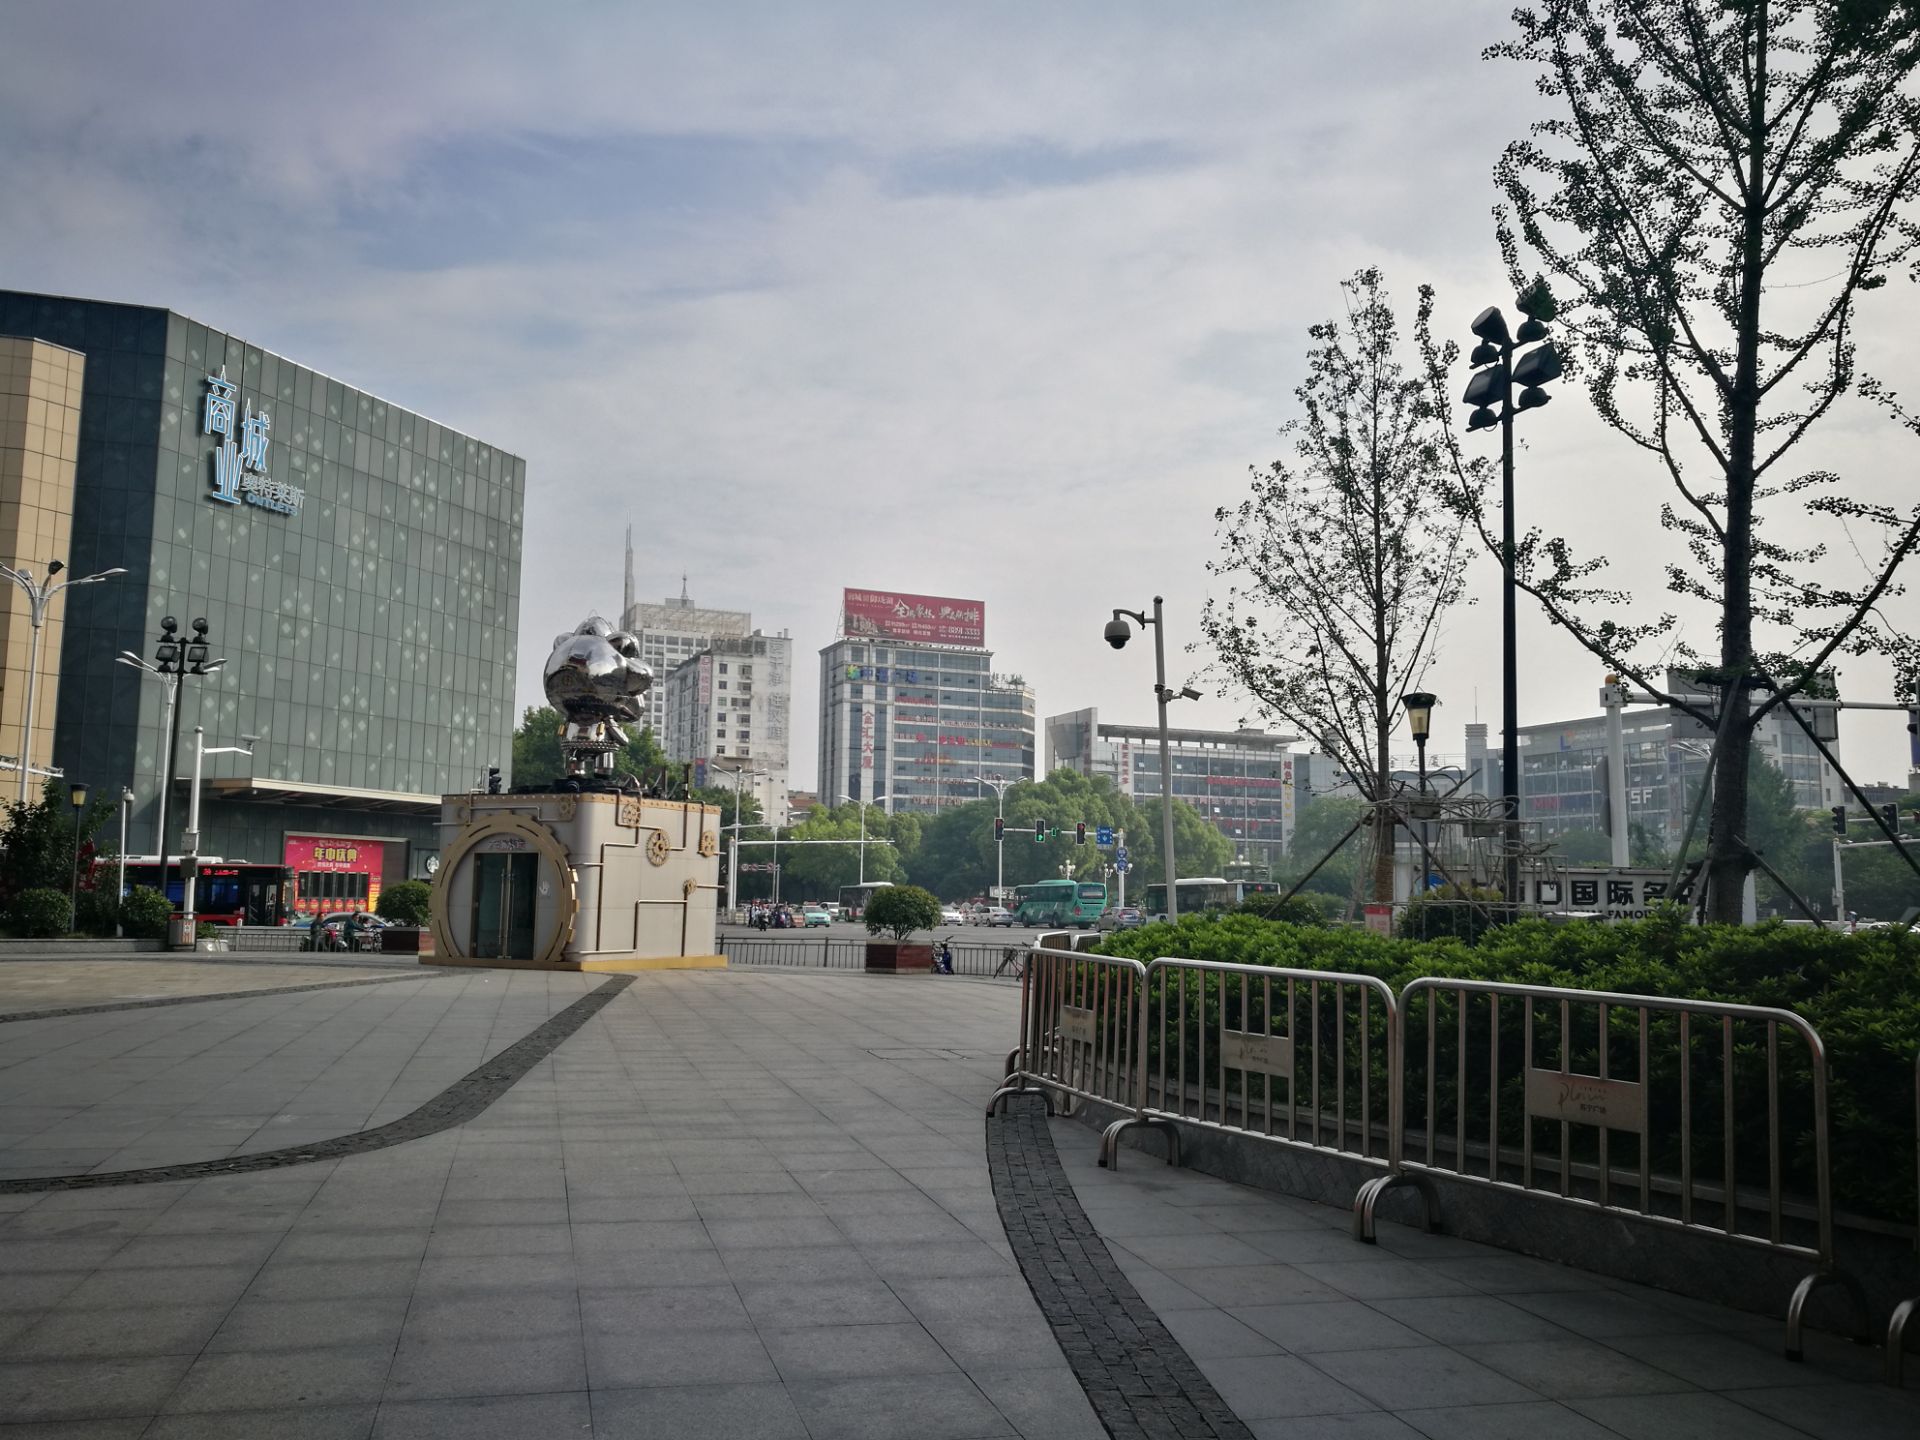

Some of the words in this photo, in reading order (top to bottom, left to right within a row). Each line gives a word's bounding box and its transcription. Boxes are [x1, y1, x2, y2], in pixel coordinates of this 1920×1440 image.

[241, 472, 304, 508] 奥特莱斯
[246, 491, 298, 517] OUTLETS
[313, 847, 357, 862] 年中庆典
